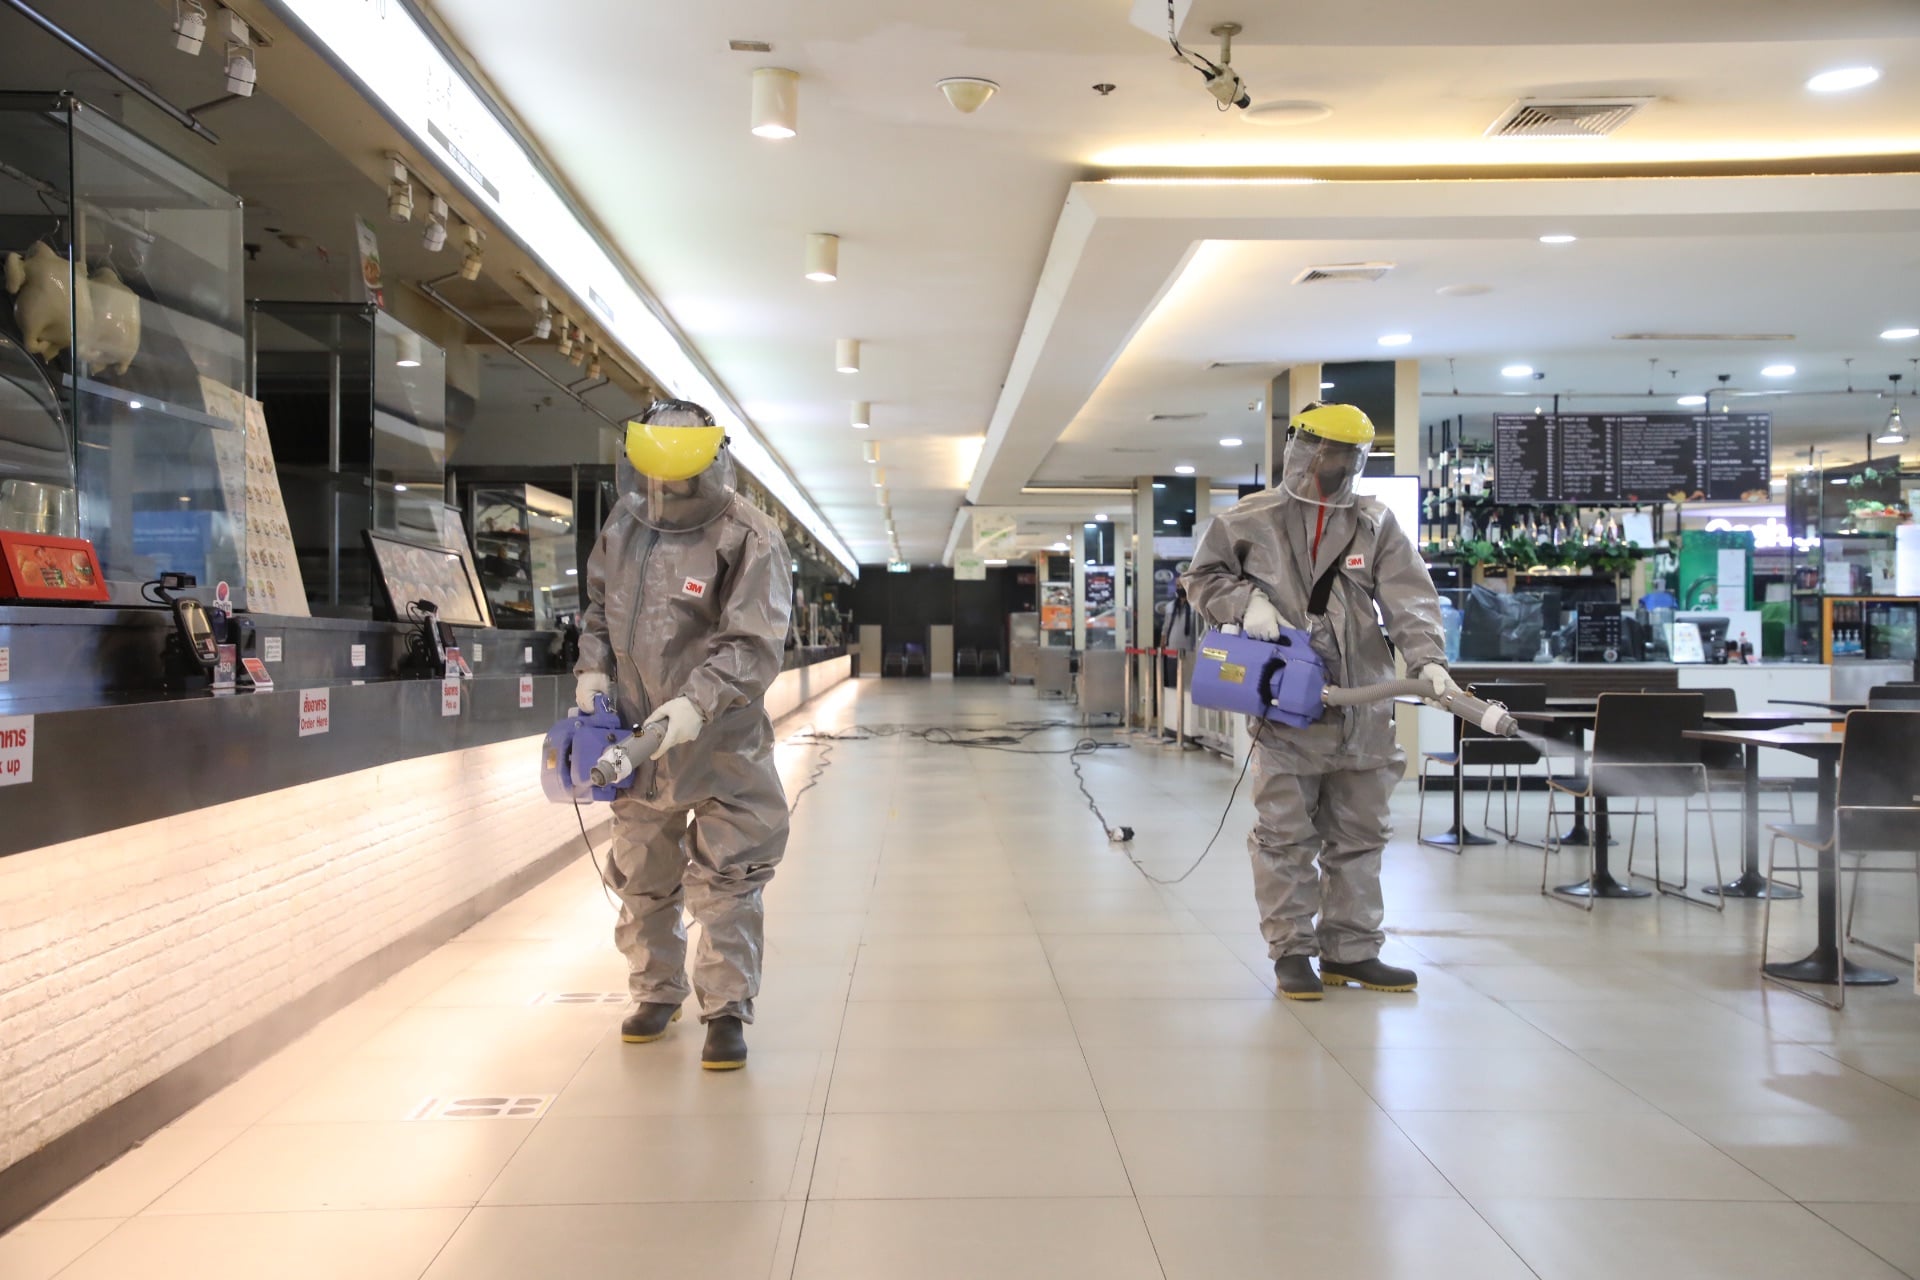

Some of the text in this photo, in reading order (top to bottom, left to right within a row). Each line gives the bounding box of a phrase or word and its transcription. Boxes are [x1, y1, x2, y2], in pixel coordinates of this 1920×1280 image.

[1348, 557, 1362, 566] 3M
[686, 581, 703, 593] 3M
[7, 759, 20, 777] up
